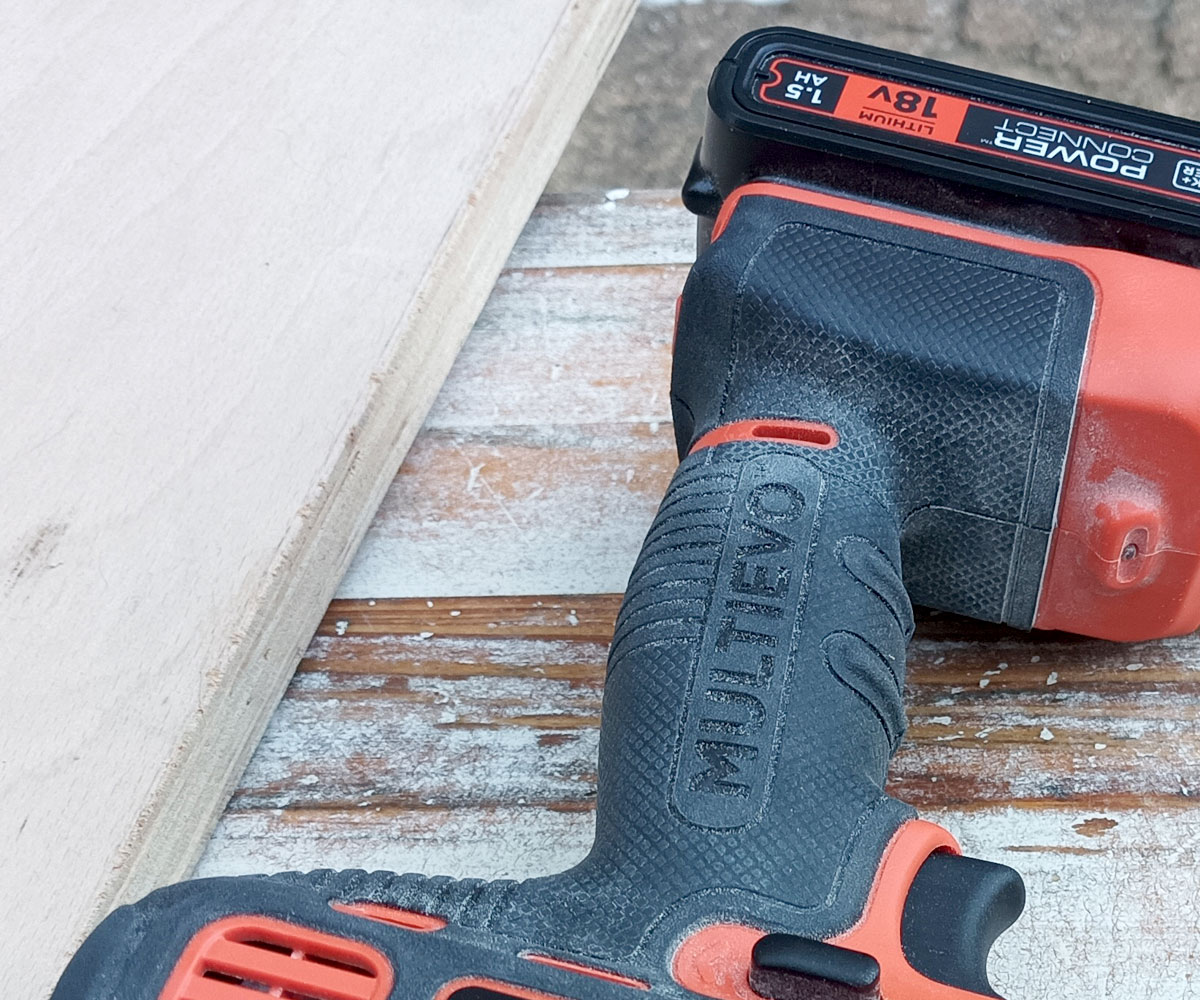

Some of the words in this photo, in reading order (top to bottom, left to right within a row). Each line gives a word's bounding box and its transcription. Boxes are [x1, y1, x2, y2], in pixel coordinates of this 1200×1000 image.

[794, 70, 828, 86] AH
[785, 83, 822, 104] 1.5
[859, 110, 935, 135] LITHIUM
[994, 118, 1154, 164] CONNECT
[689, 482, 806, 800] MULTIEVO
